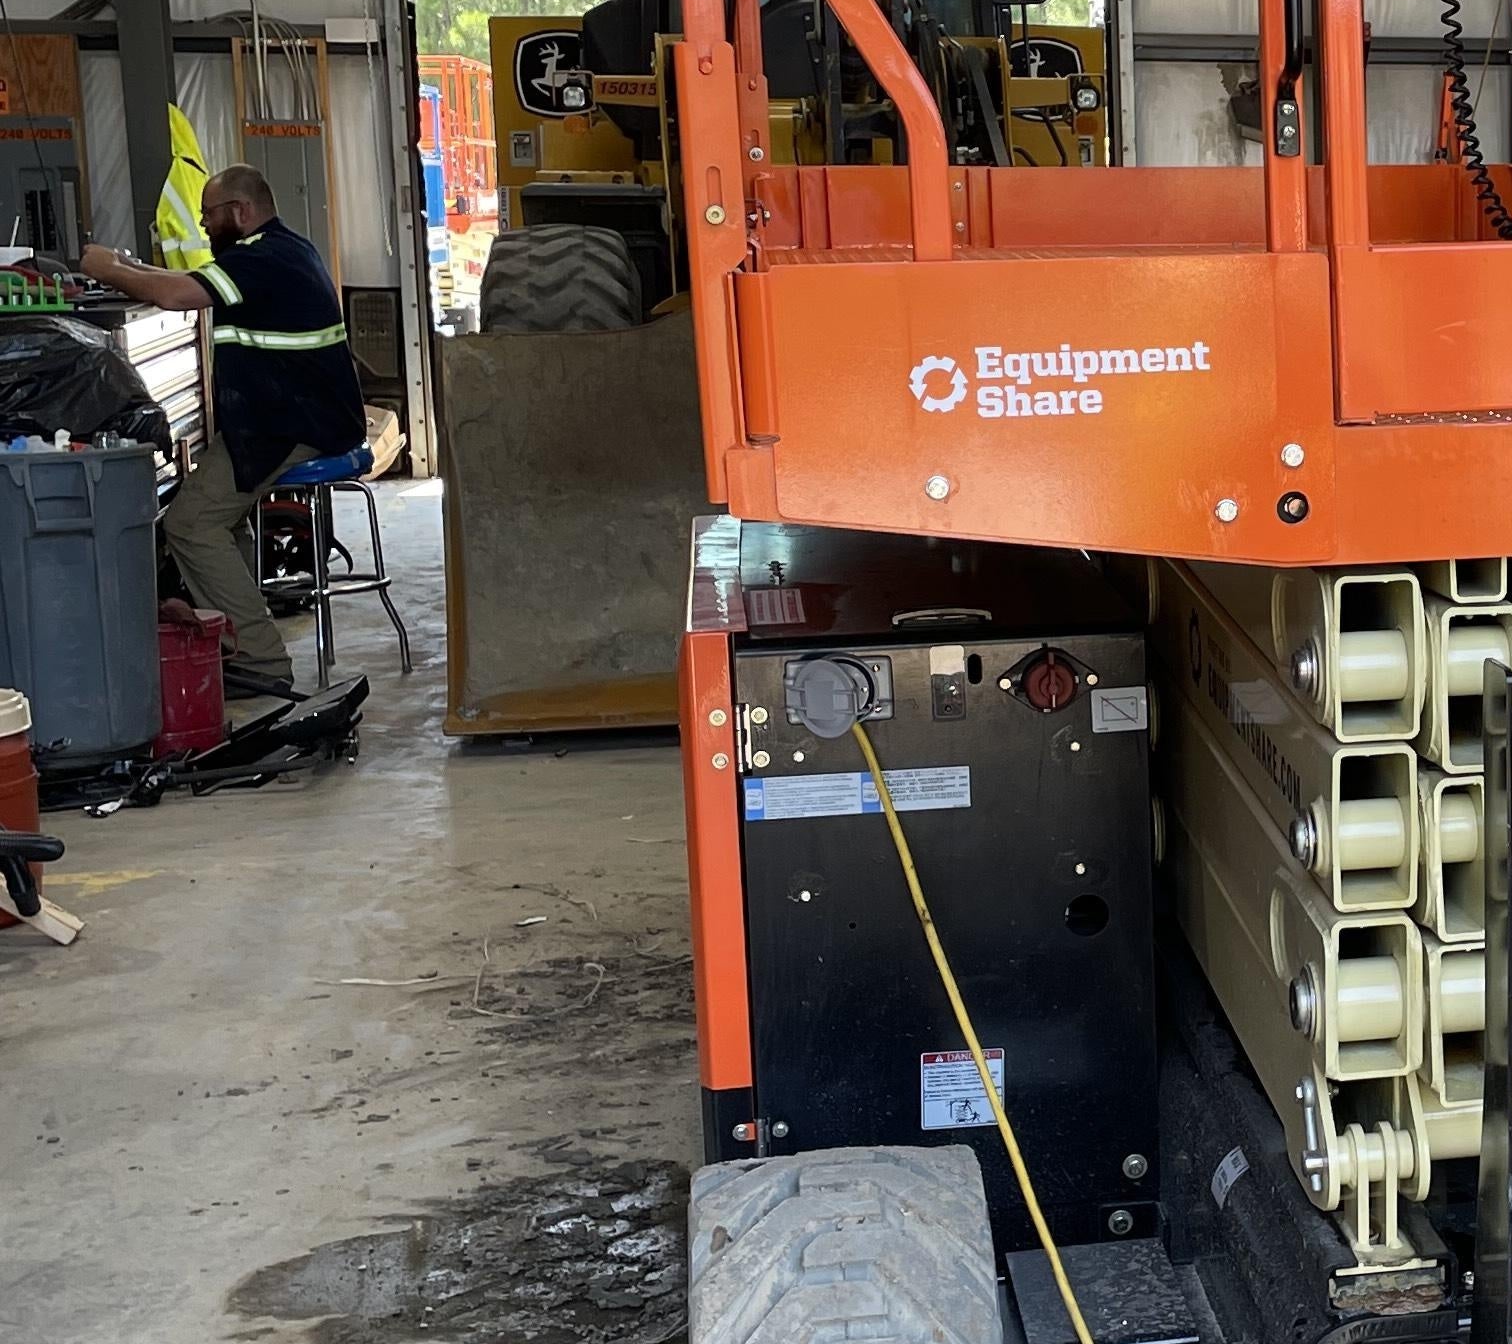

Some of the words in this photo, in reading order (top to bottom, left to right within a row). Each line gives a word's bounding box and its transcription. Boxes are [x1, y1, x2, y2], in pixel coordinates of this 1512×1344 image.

[600, 81, 657, 96] 150315
[32, 128, 72, 140] VOLTS
[252, 125, 274, 136] 240
[280, 125, 321, 136] VOLTS
[974, 341, 1211, 385] Equipment
[976, 385, 1104, 418] Share
[947, 1051, 991, 1062] DANGR
